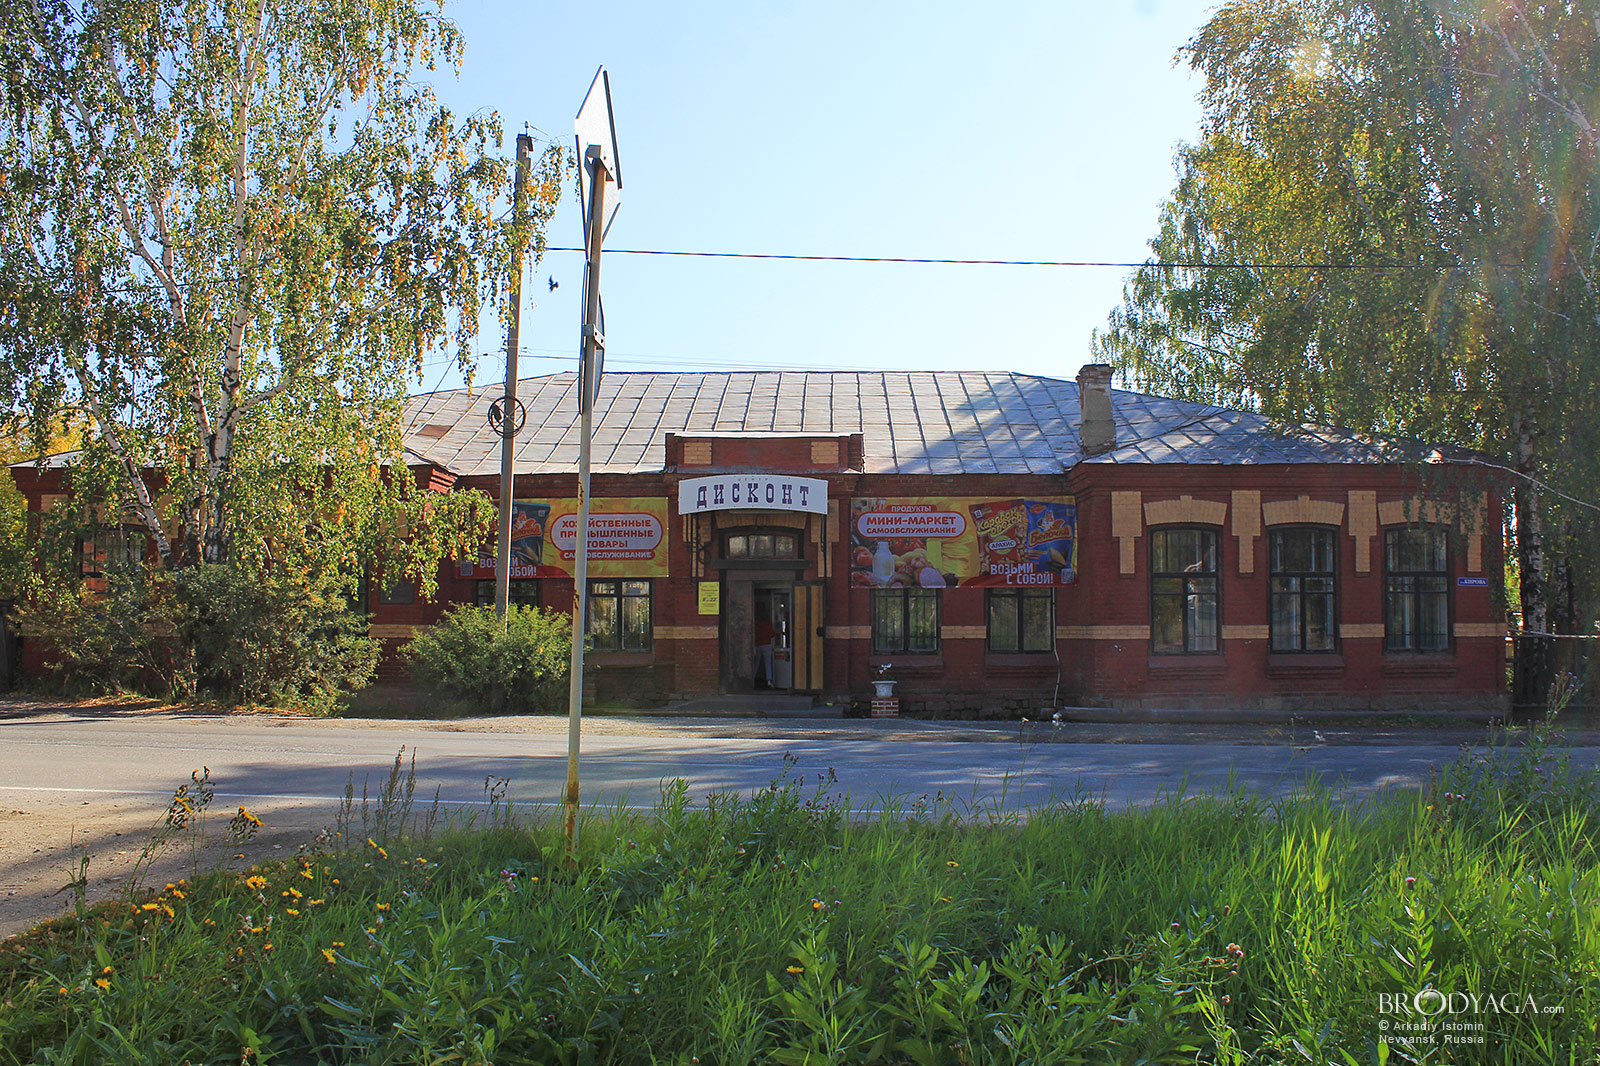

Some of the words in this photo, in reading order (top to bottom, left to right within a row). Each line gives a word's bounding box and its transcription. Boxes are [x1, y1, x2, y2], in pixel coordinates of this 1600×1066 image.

[696, 482, 809, 509] ДИСКОНТ
[562, 518, 651, 528] ХОЙСТВЕННЫЕ
[866, 516, 957, 526] МИНИ-МАРКЕТ
[560, 530, 654, 538] ПРЫШЛЕННЫЕ
[991, 540, 1014, 549] АРАХИС
[480, 558, 519, 569] ВОЗИ
[990, 563, 1033, 575] ВОЗЬМИ
[1006, 574, 1013, 584] С
[1016, 571, 1054, 584] СОБОЙ!
